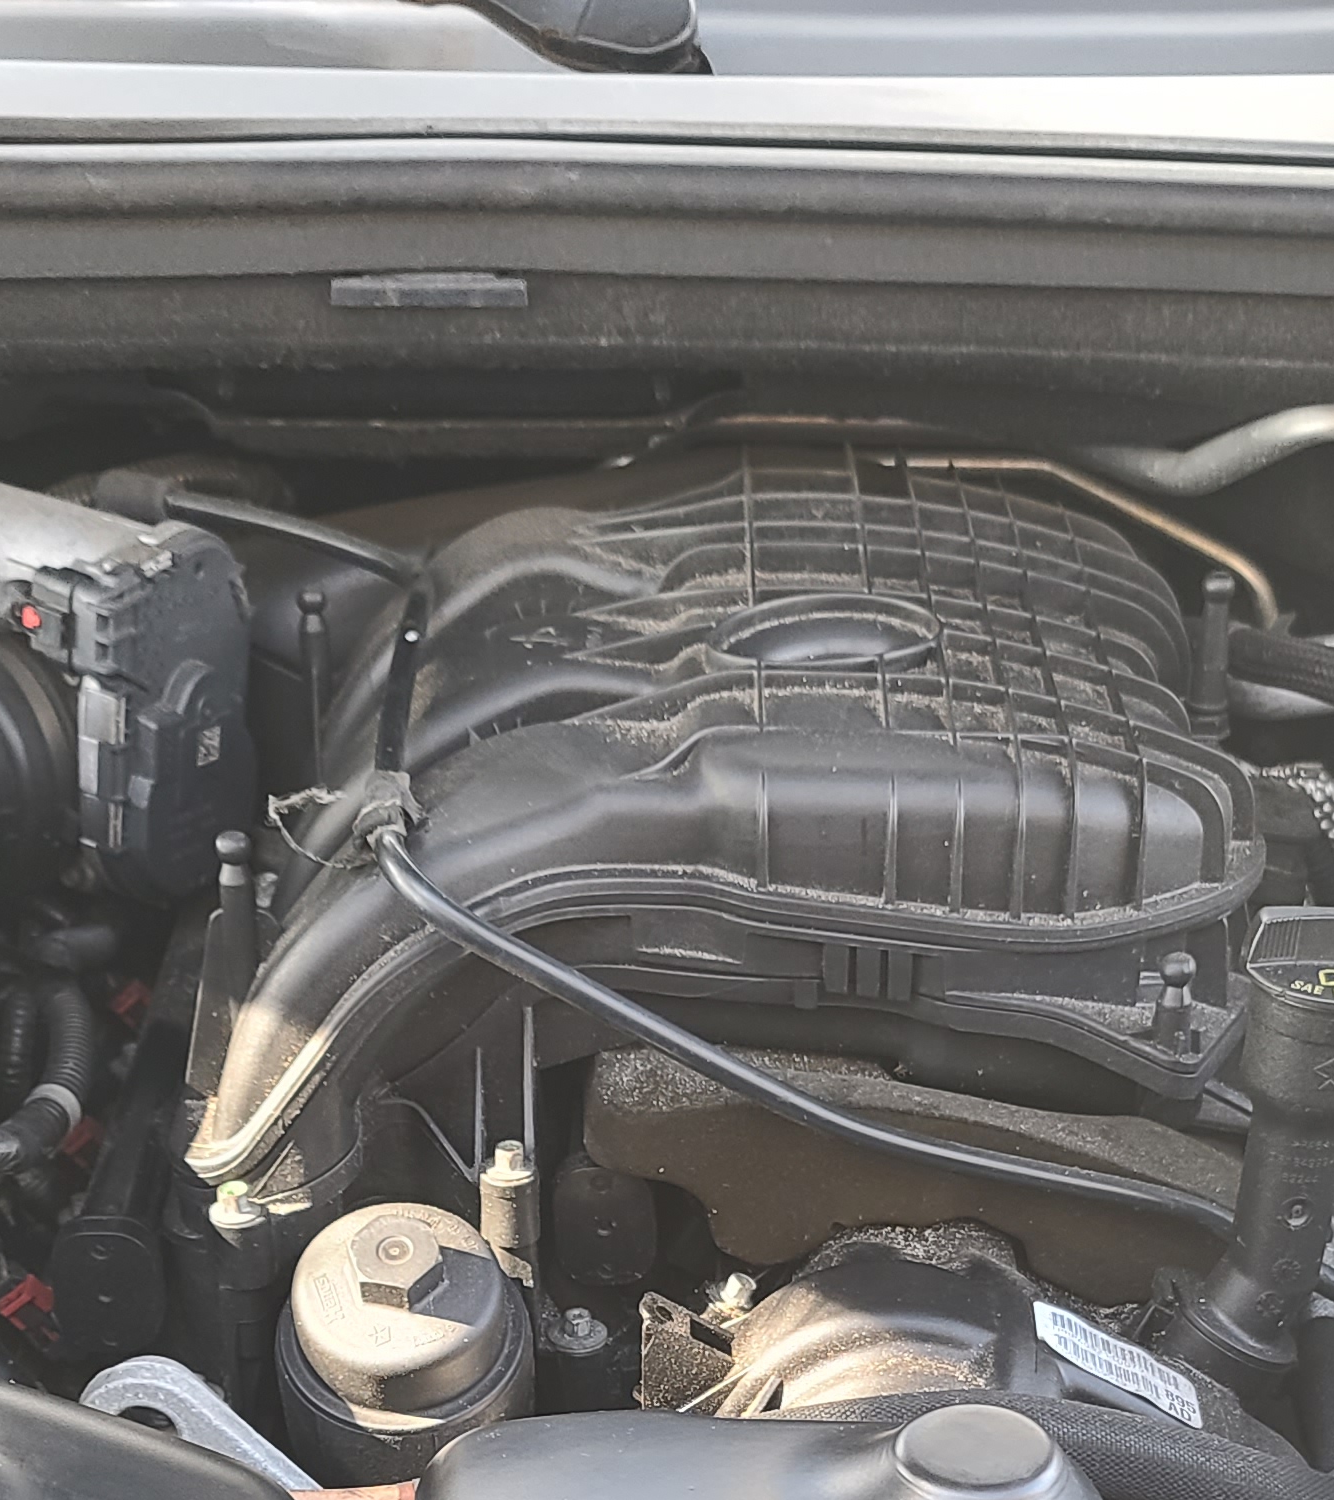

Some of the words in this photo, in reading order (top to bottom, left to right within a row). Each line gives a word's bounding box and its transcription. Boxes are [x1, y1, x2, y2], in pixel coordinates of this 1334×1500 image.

[1290, 980, 1325, 996] SAE
[1164, 1388, 1197, 1415] 895
[1168, 1402, 1192, 1422] AD
